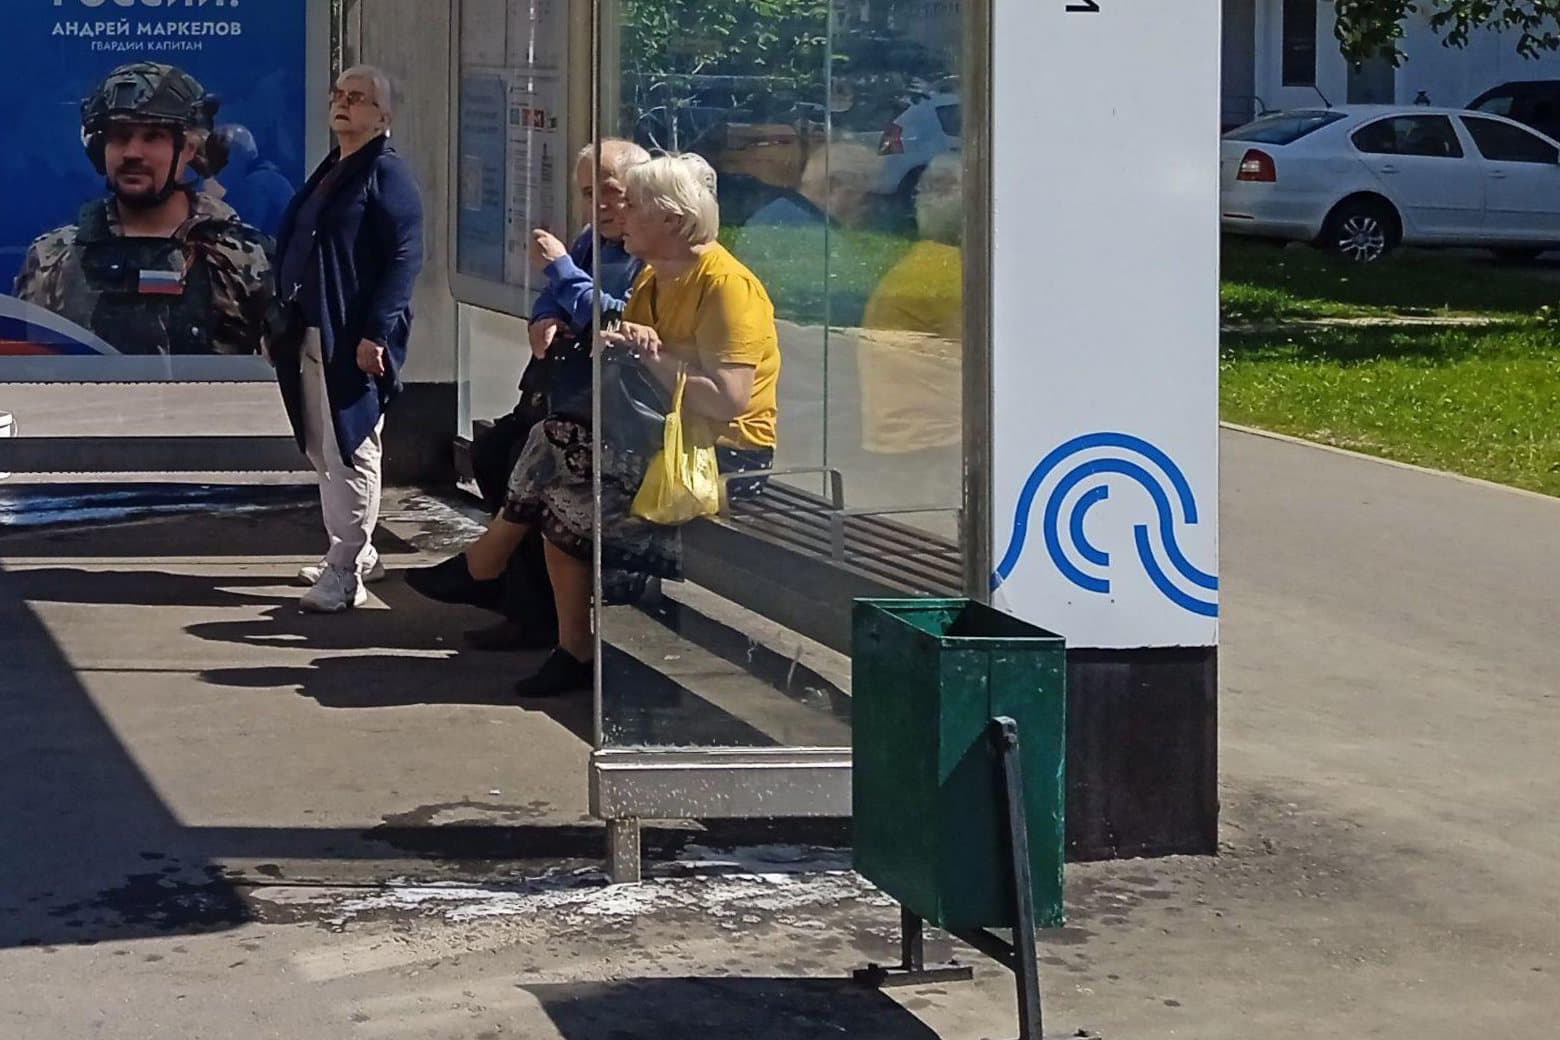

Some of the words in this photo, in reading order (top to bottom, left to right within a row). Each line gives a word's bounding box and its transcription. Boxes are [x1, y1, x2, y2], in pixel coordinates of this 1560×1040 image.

[52, 18, 130, 38] АНДРЕЙ
[136, 22, 242, 36] МАРКЕЛОВ
[91, 41, 143, 52] ГВАРДИИ
[147, 41, 202, 51] КАПИТАН
